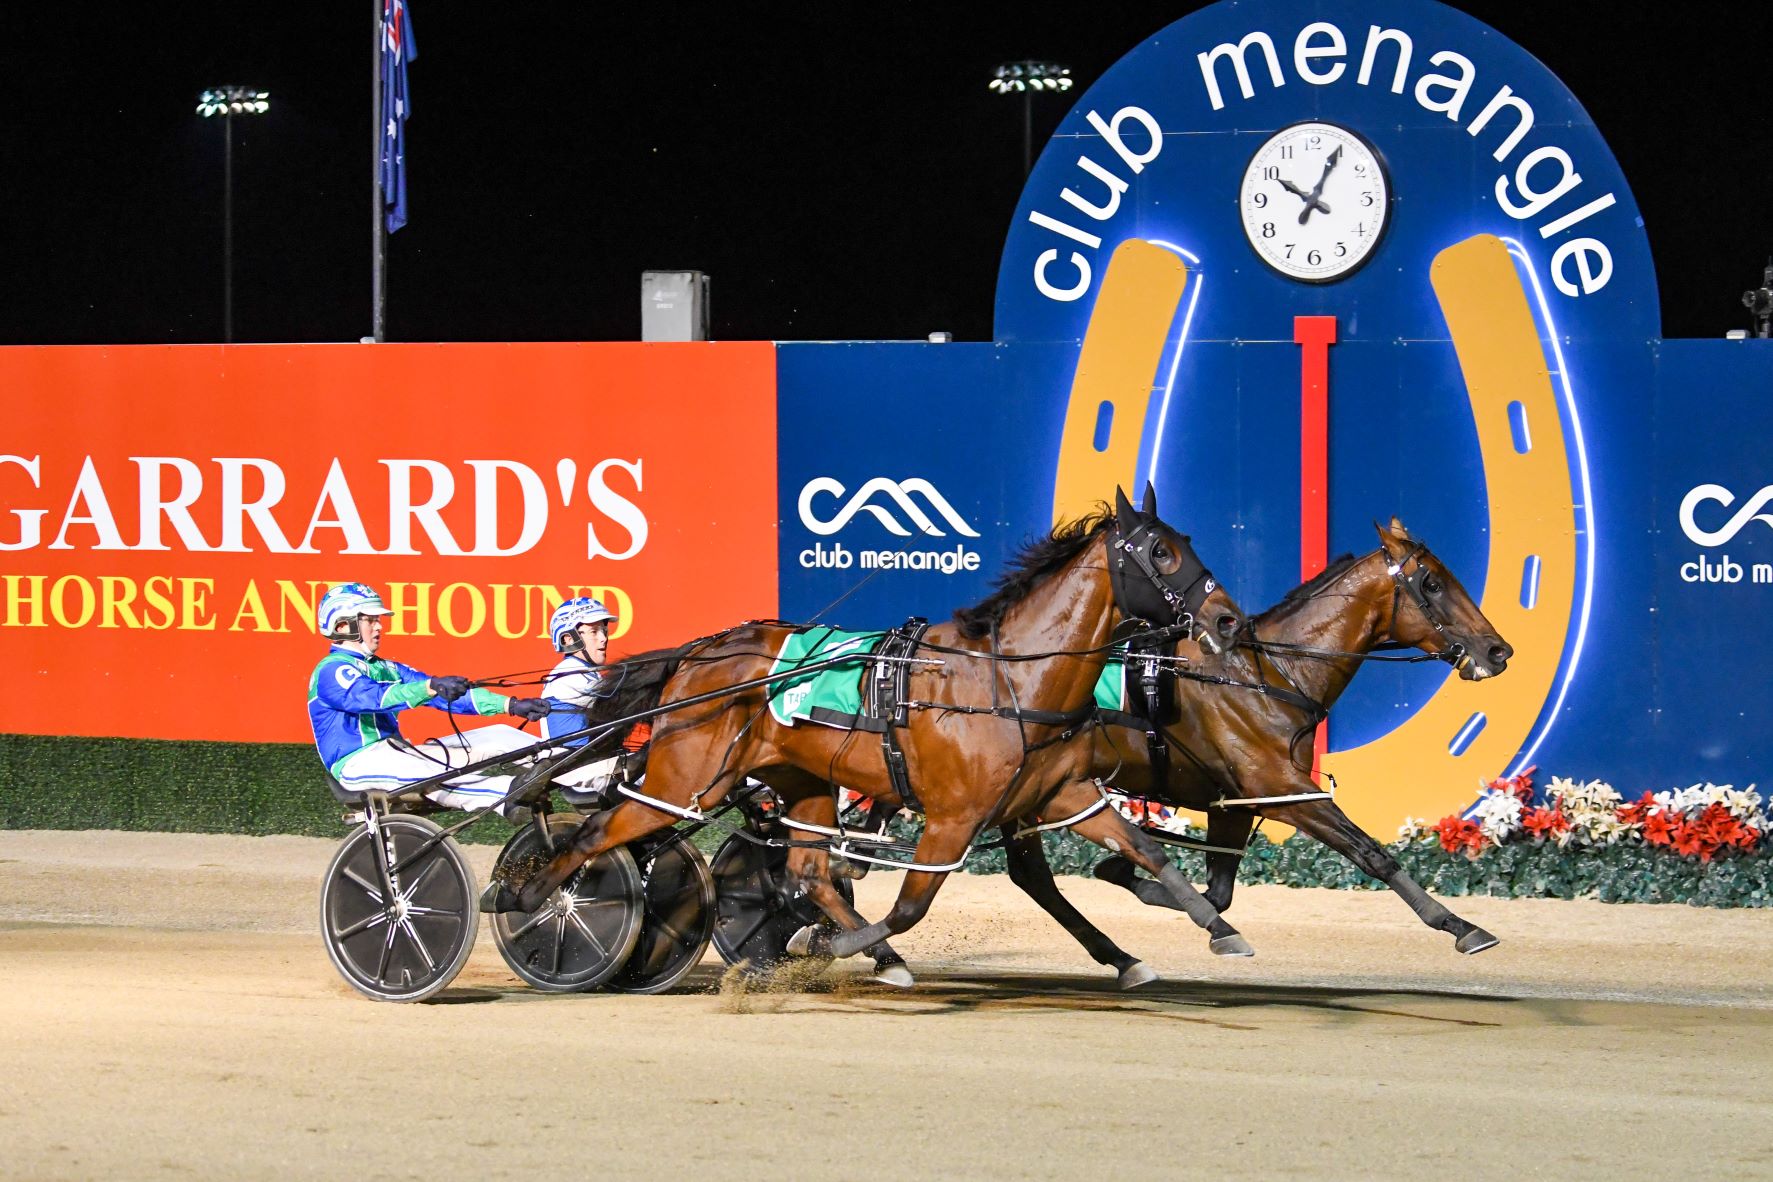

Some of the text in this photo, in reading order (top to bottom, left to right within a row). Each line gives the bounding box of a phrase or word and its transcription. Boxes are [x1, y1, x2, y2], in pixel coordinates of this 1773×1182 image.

[1305, 136, 1321, 150] 12
[1280, 145, 1293, 159] 11
[1028, 21, 1617, 302] club menangle
[1263, 166, 1279, 180] 10
[1354, 164, 1366, 178] 2
[1254, 193, 1268, 208] 9
[1360, 191, 1374, 206] 3
[1262, 222, 1276, 238] 8
[1350, 221, 1366, 237] 4
[1285, 244, 1296, 259] 7
[1334, 242, 1347, 257] 5
[1307, 250, 1322, 266] 6
[0, 455, 649, 560] GARRARD'S
[799, 542, 981, 574] club menangle
[1680, 554, 1744, 583] club
[1, 574, 634, 641] HORSE AN HOUND
